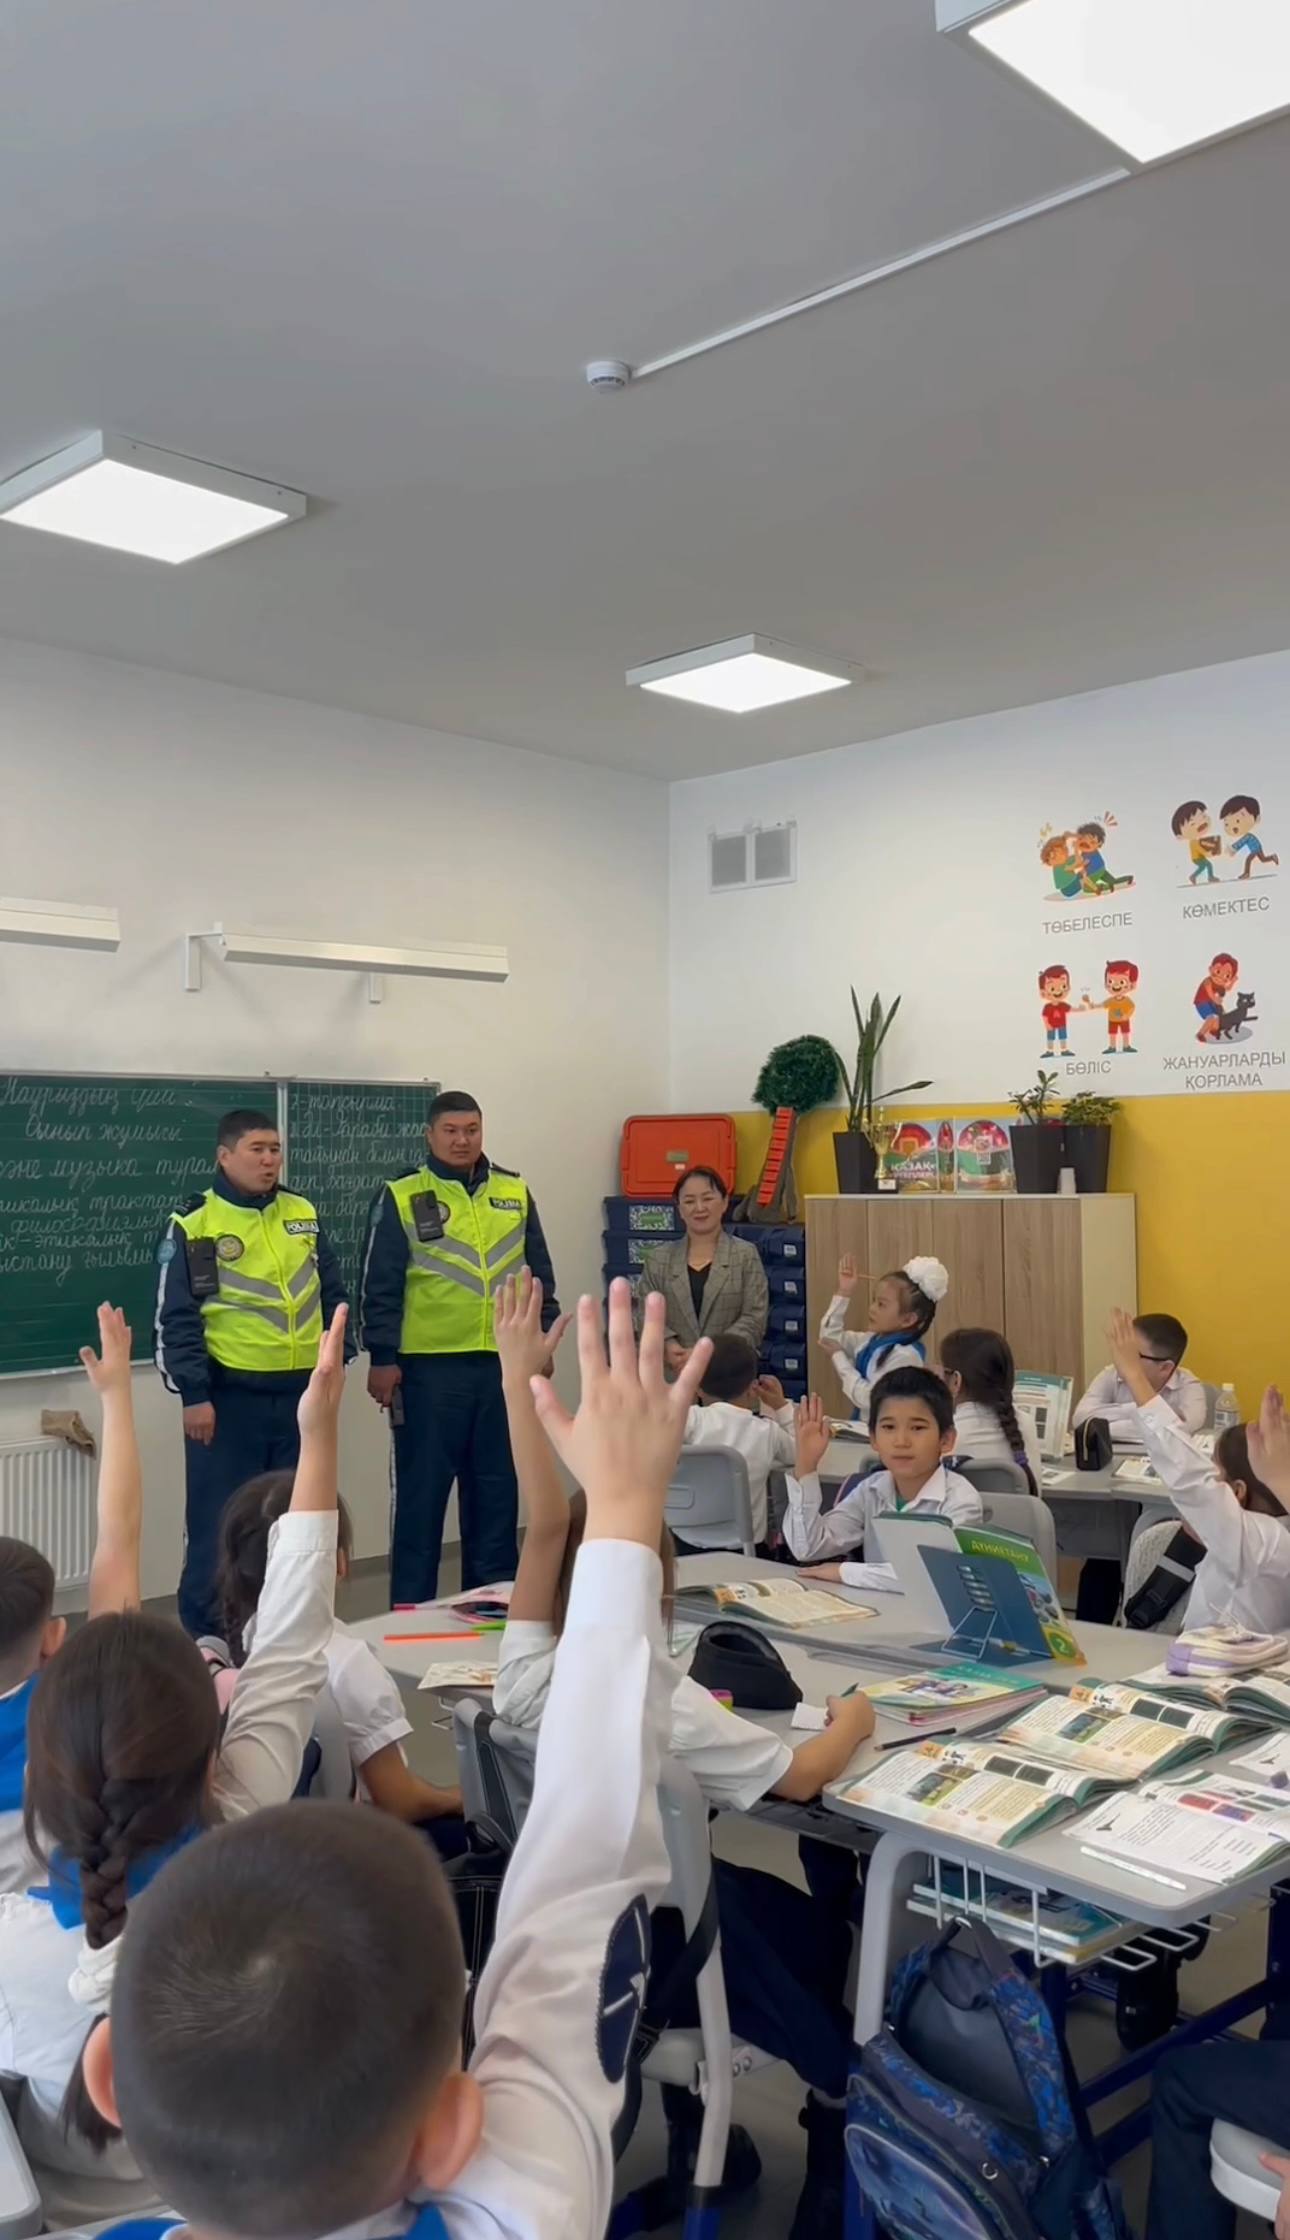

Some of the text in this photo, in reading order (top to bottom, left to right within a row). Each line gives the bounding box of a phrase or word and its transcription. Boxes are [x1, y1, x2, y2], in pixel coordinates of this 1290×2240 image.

[1182, 896, 1270, 919] КӨМЕКТЕС
[1042, 912, 1133, 935] ТӨБЕЛЕСПЕ
[1066, 1061, 1112, 1076] БӨЛІС
[1163, 1051, 1286, 1071] ЖАНУАРЛАРДЫ
[1185, 1074, 1263, 1090] ҚОРЛАМА
[51, 1158, 143, 1191] музыка
